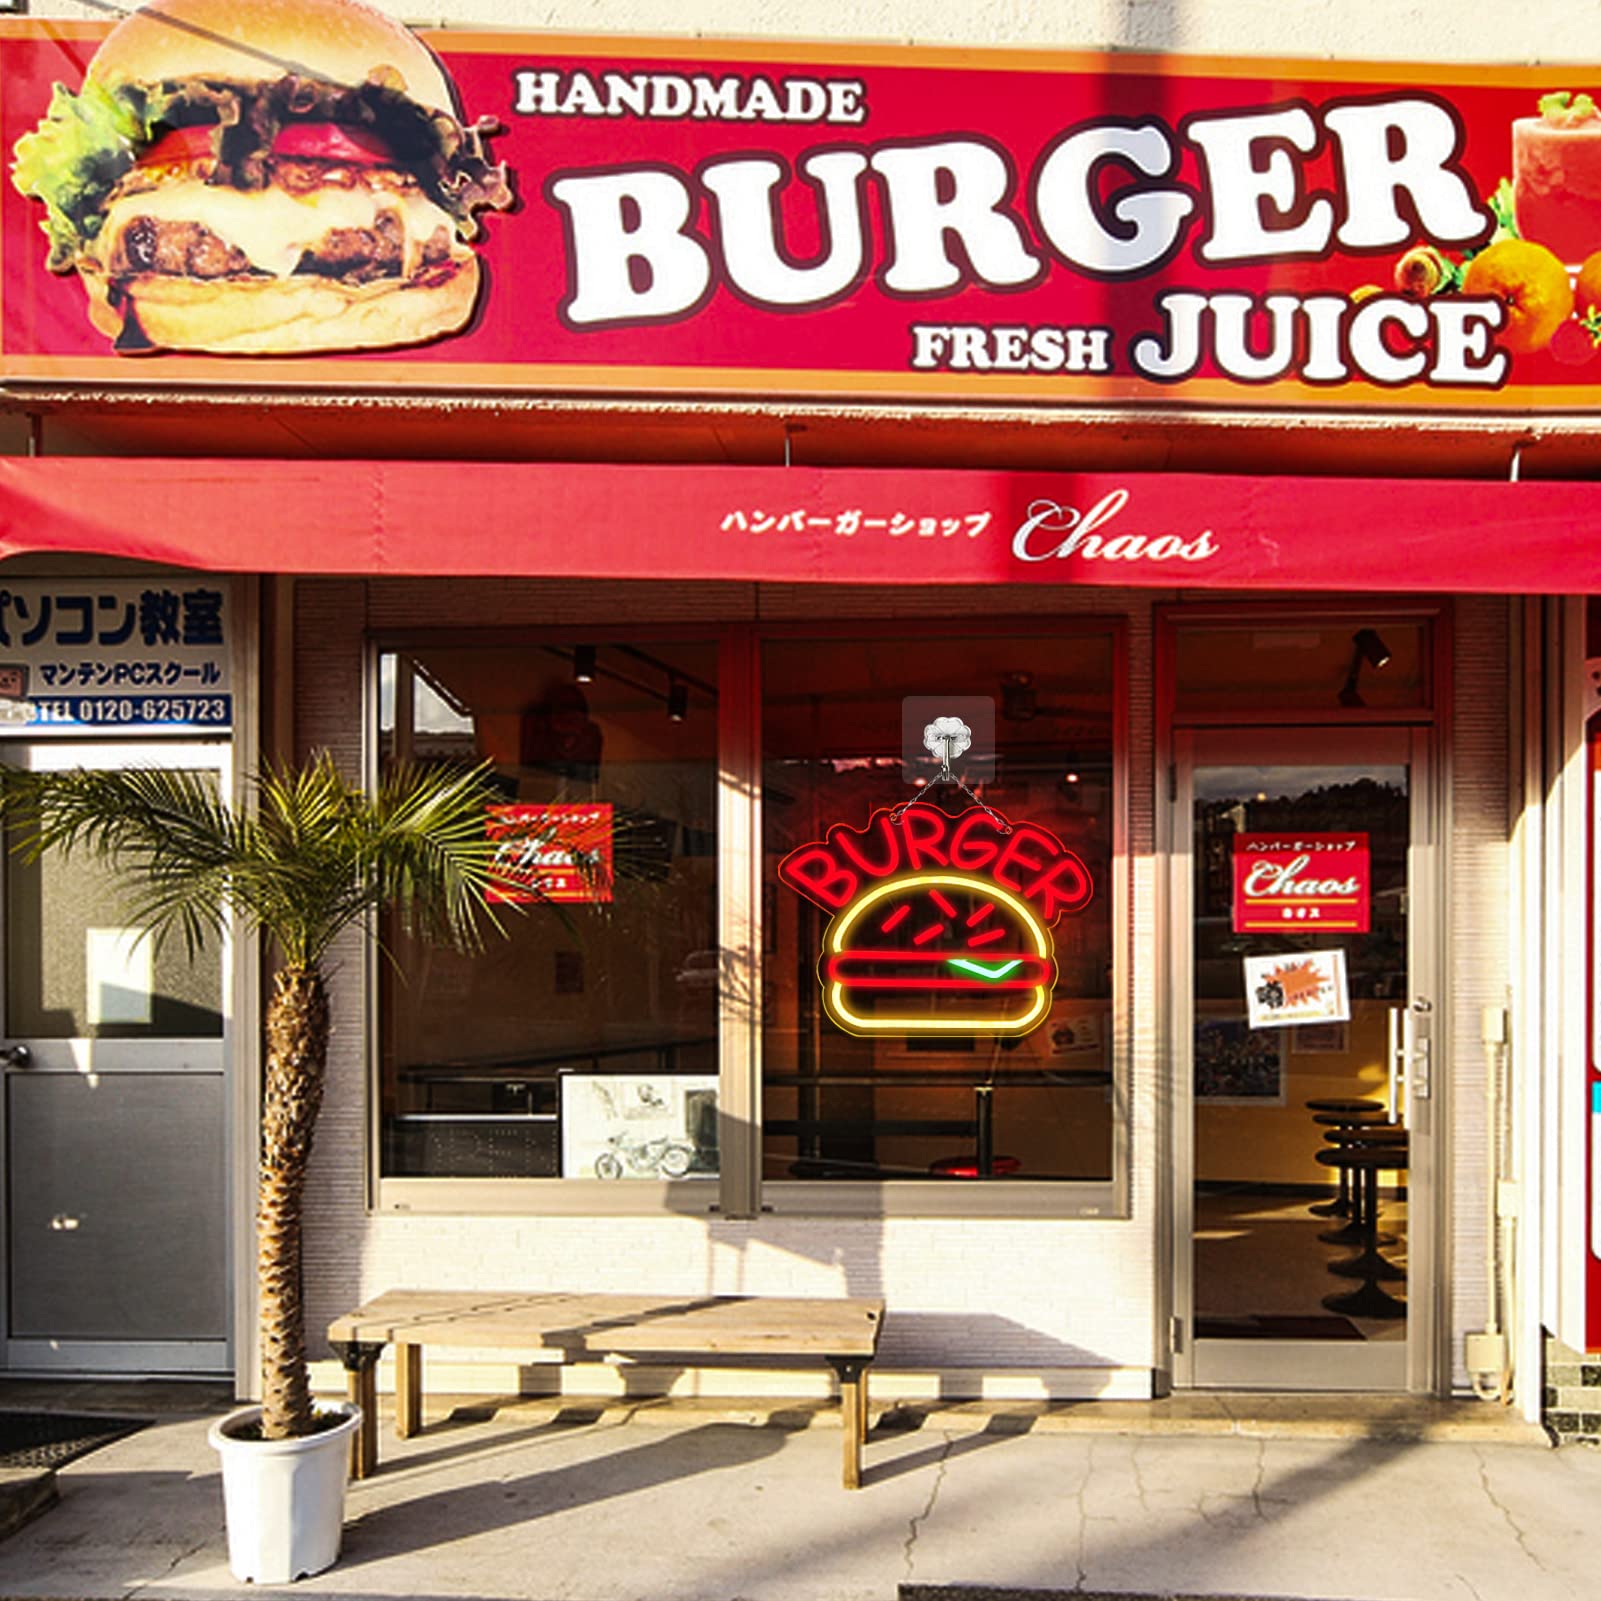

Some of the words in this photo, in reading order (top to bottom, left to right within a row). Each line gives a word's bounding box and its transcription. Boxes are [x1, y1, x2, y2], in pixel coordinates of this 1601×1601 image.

[514, 71, 866, 123] HANDMADE
[552, 97, 1489, 327] BURGER
[912, 325, 1109, 374] FRESH
[1135, 292, 1508, 386] JUICE
[720, 509, 992, 537] ハンバーガーショップ
[1012, 488, 1219, 562] Chaos
[39, 661, 221, 686] マンテンPCスクール
[37, 700, 75, 721] TEL
[79, 699, 226, 721] 0120-625723
[785, 808, 1088, 921] BURGER
[1243, 853, 1361, 897] Chaos
